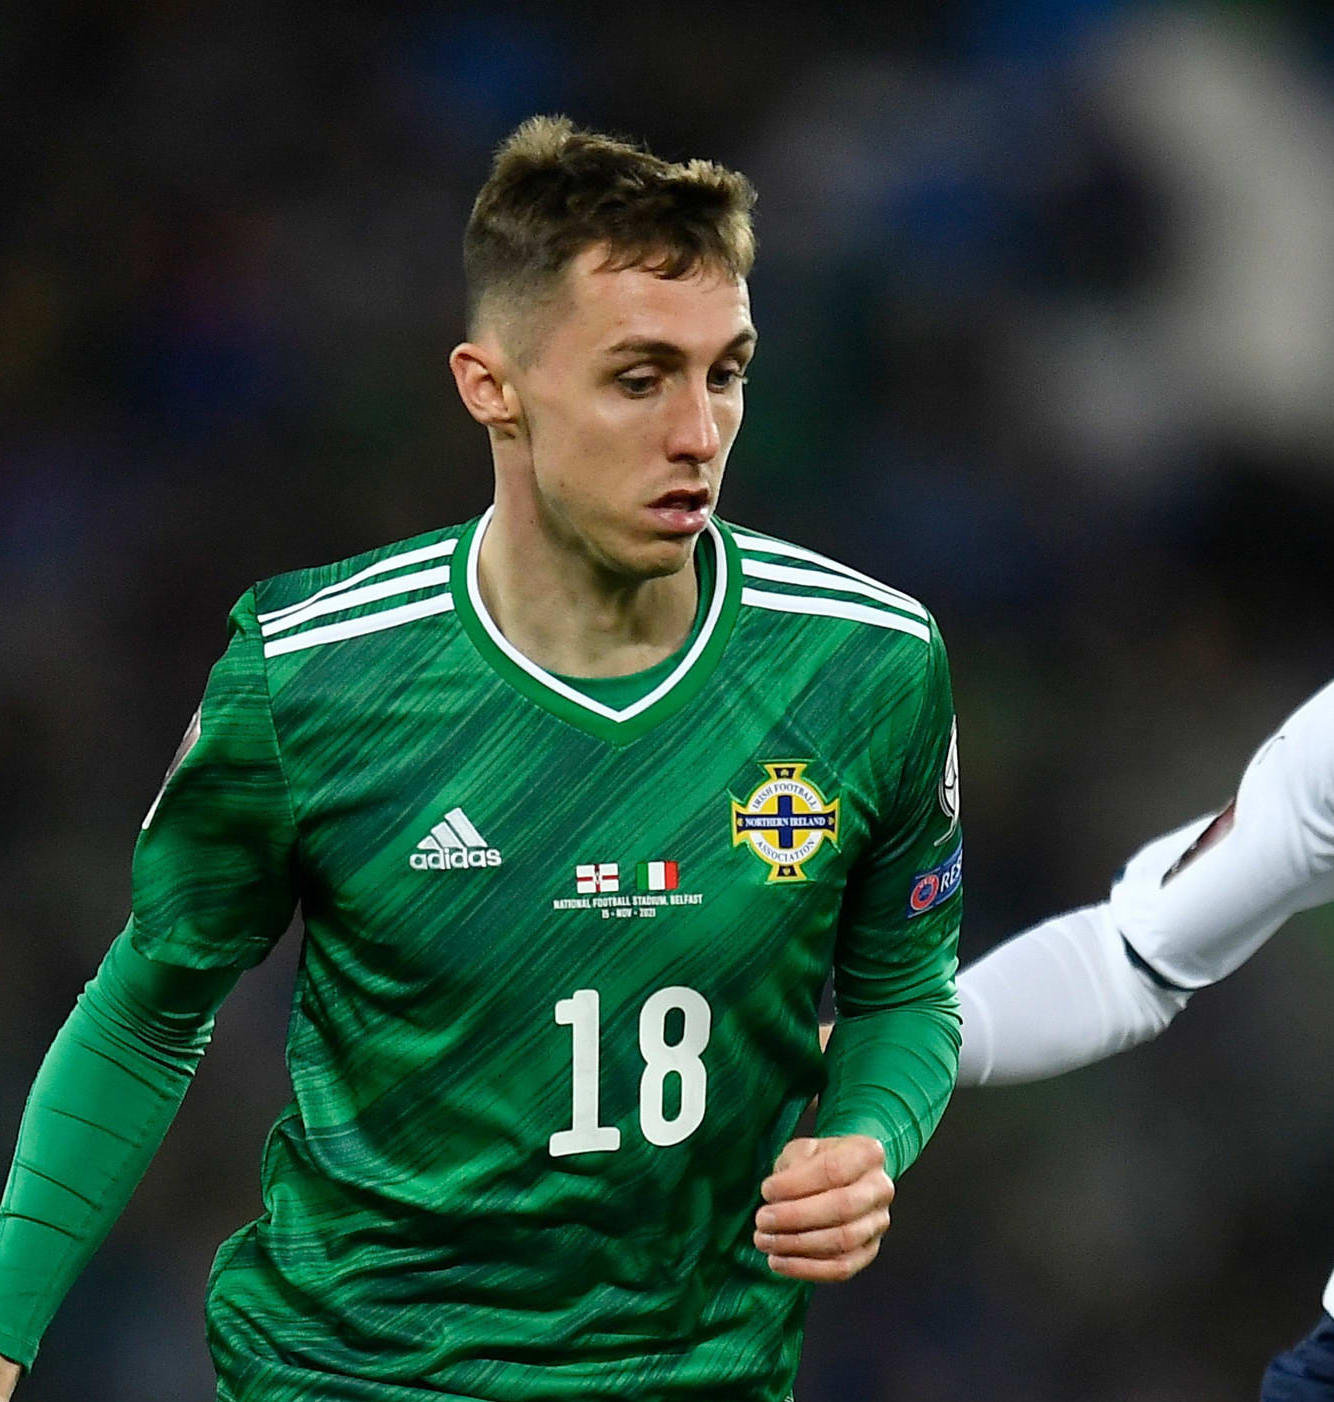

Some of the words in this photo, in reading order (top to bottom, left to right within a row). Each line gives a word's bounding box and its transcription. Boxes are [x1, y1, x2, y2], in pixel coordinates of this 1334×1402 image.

[752, 787, 775, 810] IRISH
[774, 783, 817, 810] FOOTBALL
[745, 816, 788, 827] NORTHERN
[789, 816, 826, 827] IRELAND
[409, 847, 503, 870] adidas
[755, 838, 816, 862] ASSOCIATION
[592, 896, 631, 908] FOOTBALL
[670, 893, 703, 905] BELFAST
[549, 985, 712, 1158] 18
